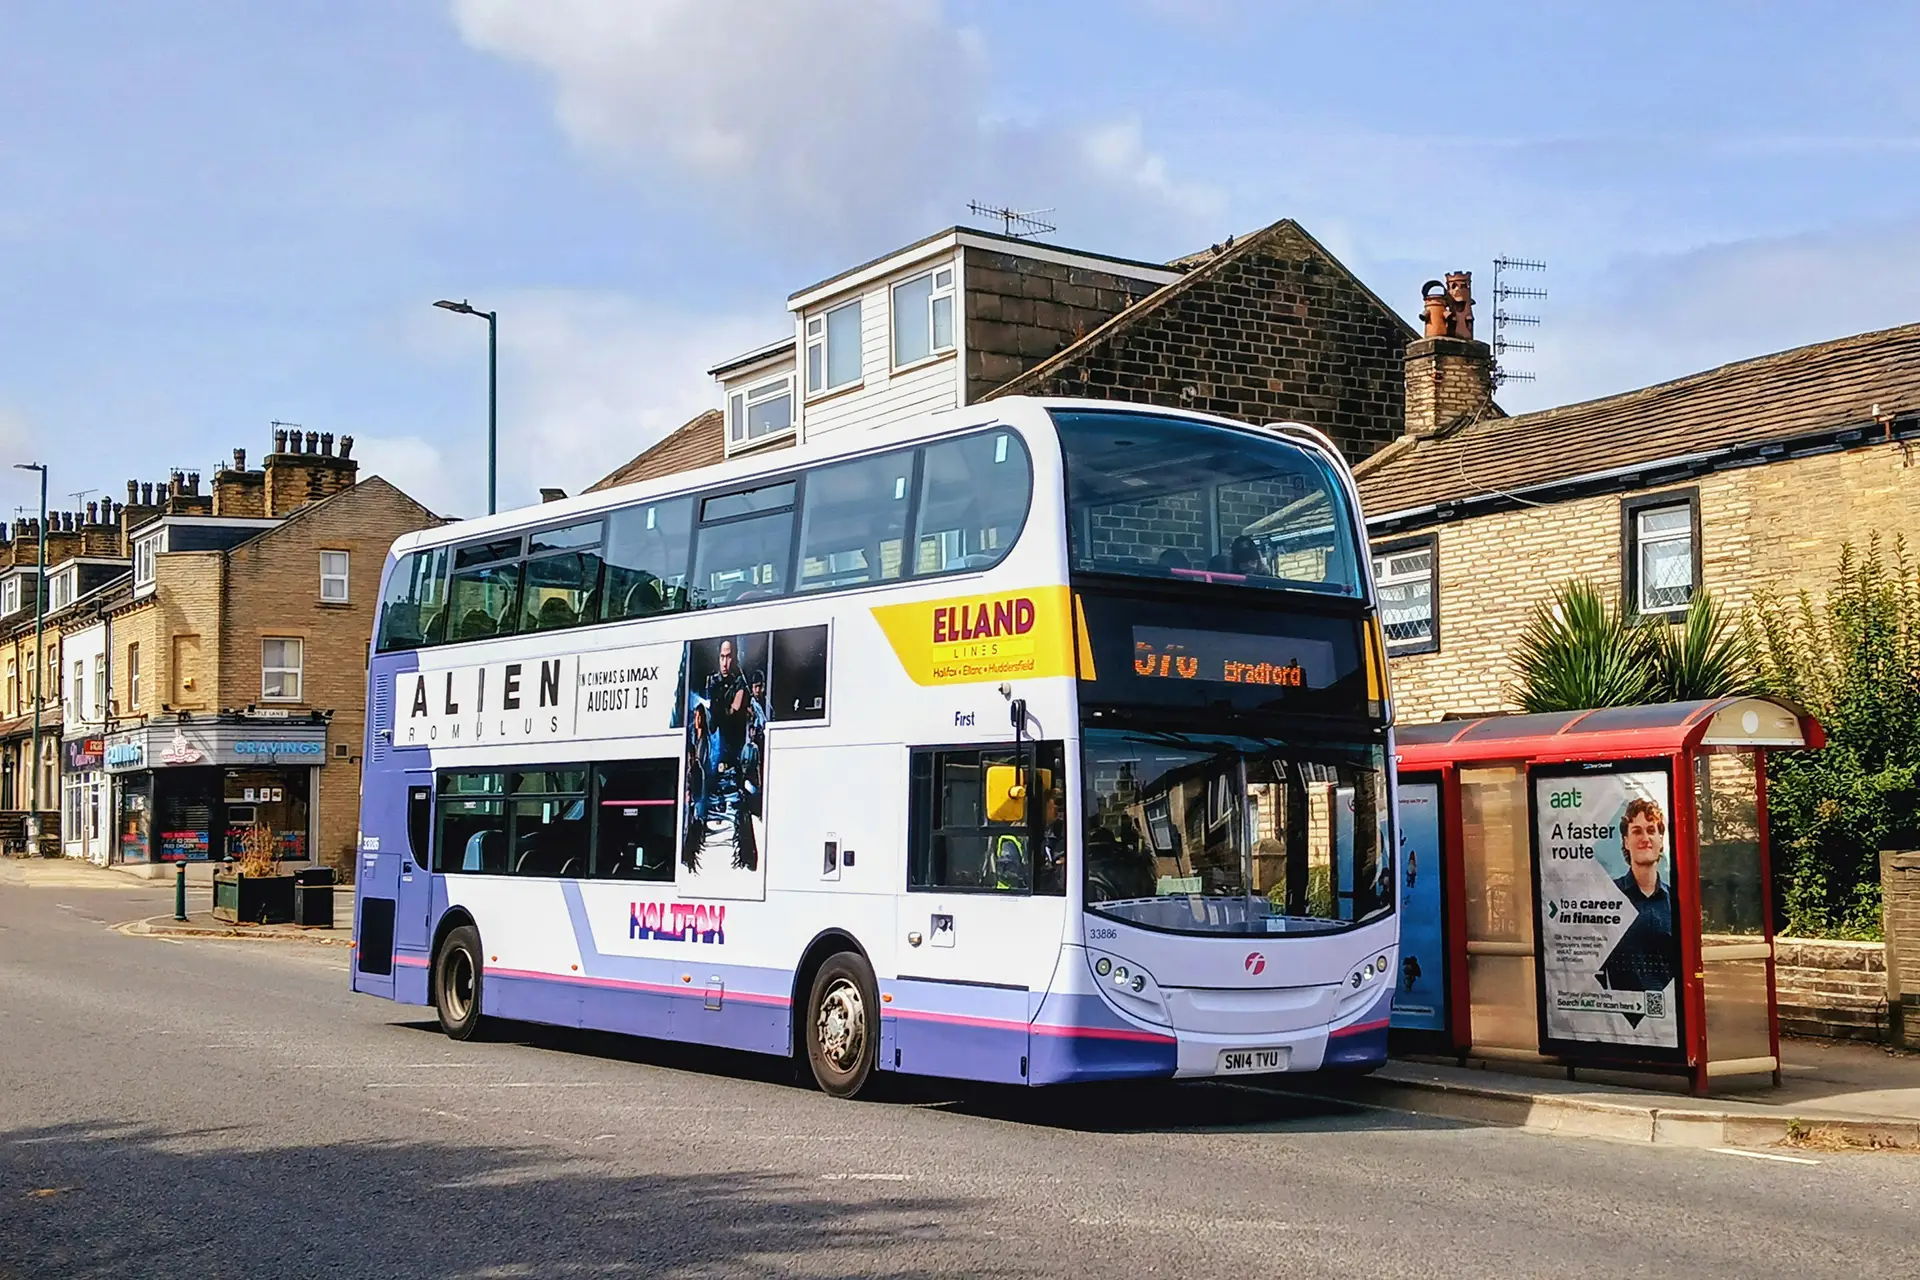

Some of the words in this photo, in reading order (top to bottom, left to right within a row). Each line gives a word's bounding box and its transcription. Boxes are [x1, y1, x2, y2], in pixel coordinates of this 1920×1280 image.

[933, 598, 1035, 643] ELLAND
[953, 644, 998, 659] LINES
[588, 670, 618, 686] CINEMAS
[620, 669, 625, 683] &
[627, 666, 660, 682] IMAX
[933, 665, 958, 678] Halifax
[1224, 660, 1301, 686] Bradford
[411, 659, 560, 718] ALIEN
[587, 688, 630, 712] AUGUST
[635, 687, 649, 709] 16
[955, 711, 975, 726] First
[409, 716, 558, 742] ROMULUS
[234, 741, 320, 754] CRAVINGS
[1550, 787, 1582, 808] aat
[1551, 824, 1563, 840] A
[1567, 822, 1615, 840] faster
[1552, 844, 1594, 859] route
[1560, 898, 1569, 909] to
[1570, 901, 1577, 909] a
[1580, 900, 1623, 910] career
[1560, 911, 1571, 924] in
[1573, 912, 1621, 924] finance
[1090, 928, 1118, 939] 33886
[1558, 998, 1579, 1007] Search
[1580, 999, 1595, 1007] AAT
[1225, 1052, 1252, 1069] SN14
[1256, 1051, 1278, 1067] TVU
